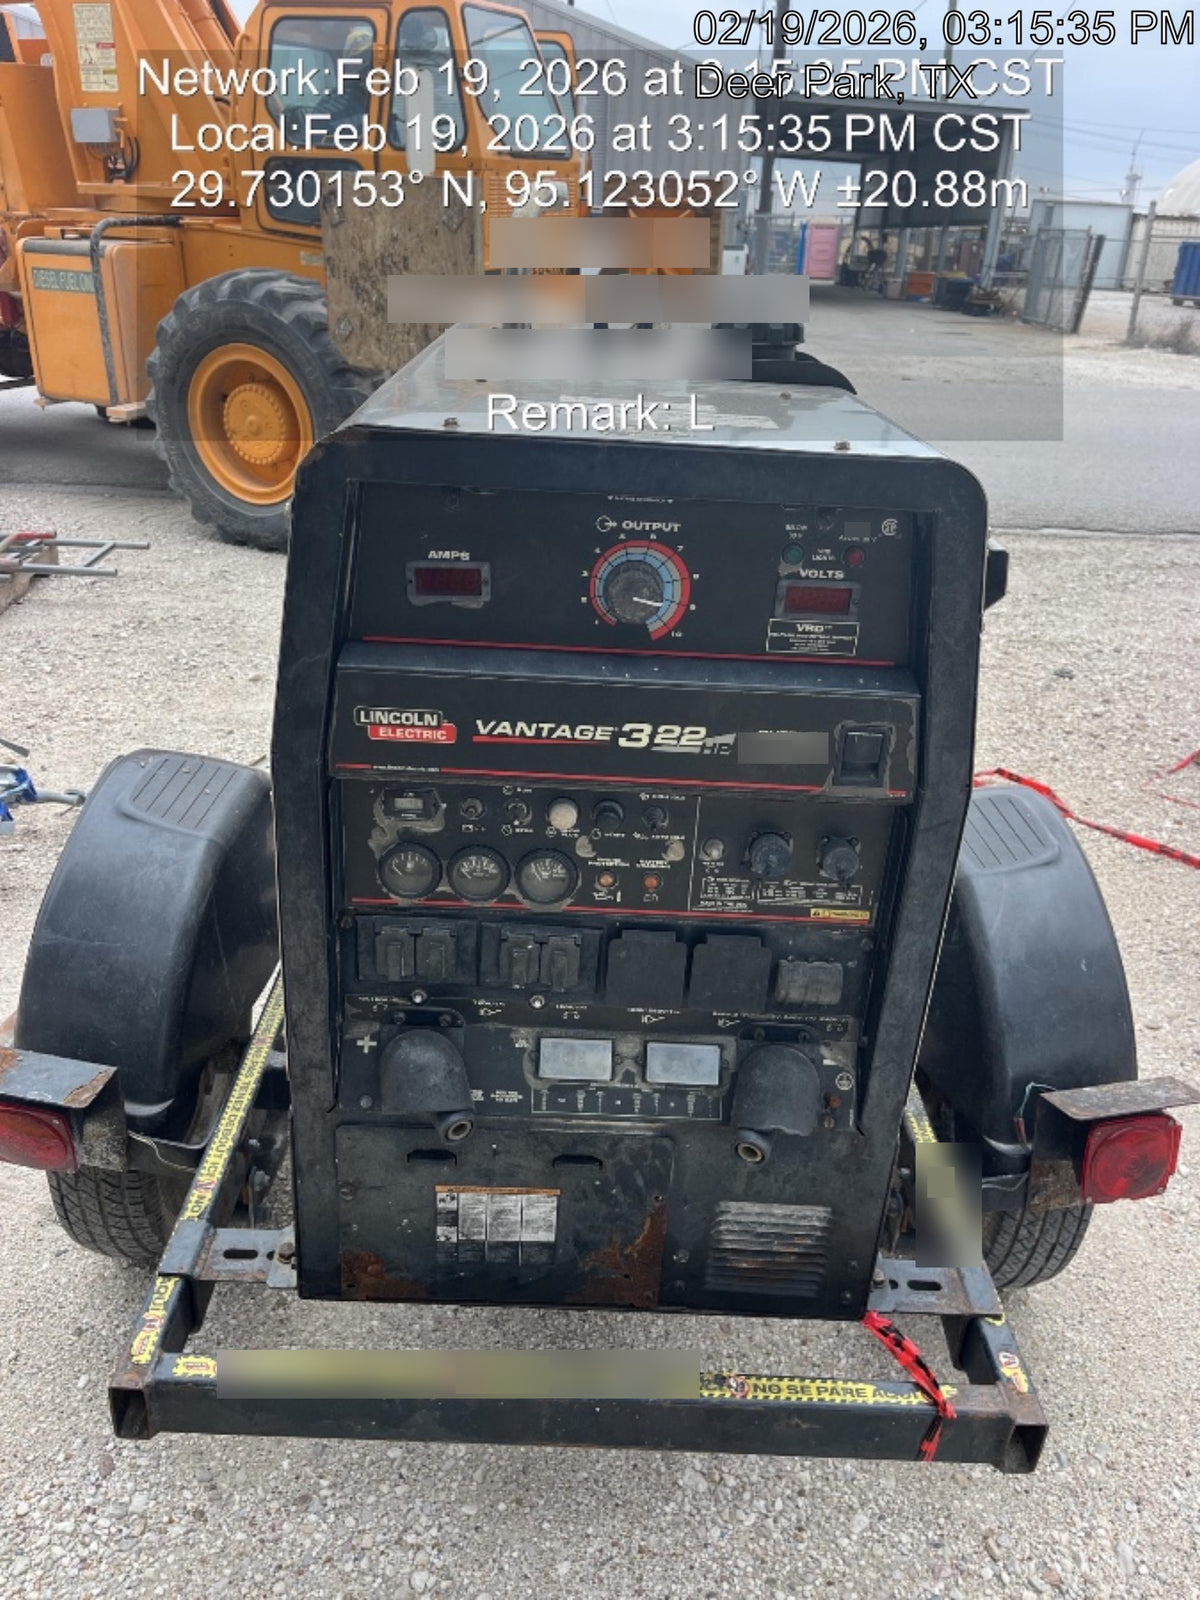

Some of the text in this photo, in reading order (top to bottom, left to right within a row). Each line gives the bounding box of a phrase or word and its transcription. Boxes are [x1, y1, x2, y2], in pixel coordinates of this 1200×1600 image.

[621, 519, 682, 533] OUTPUT
[427, 549, 471, 561] AMPS
[800, 568, 845, 580] VOLTS
[359, 710, 439, 727] LINCOLN
[378, 727, 448, 741] ELECTRIC
[475, 719, 616, 742] VANTAGE
[617, 722, 708, 749] 322
[752, 1382, 782, 1395] NO
[787, 1384, 812, 1397] SE
[815, 1385, 868, 1399] PARE
